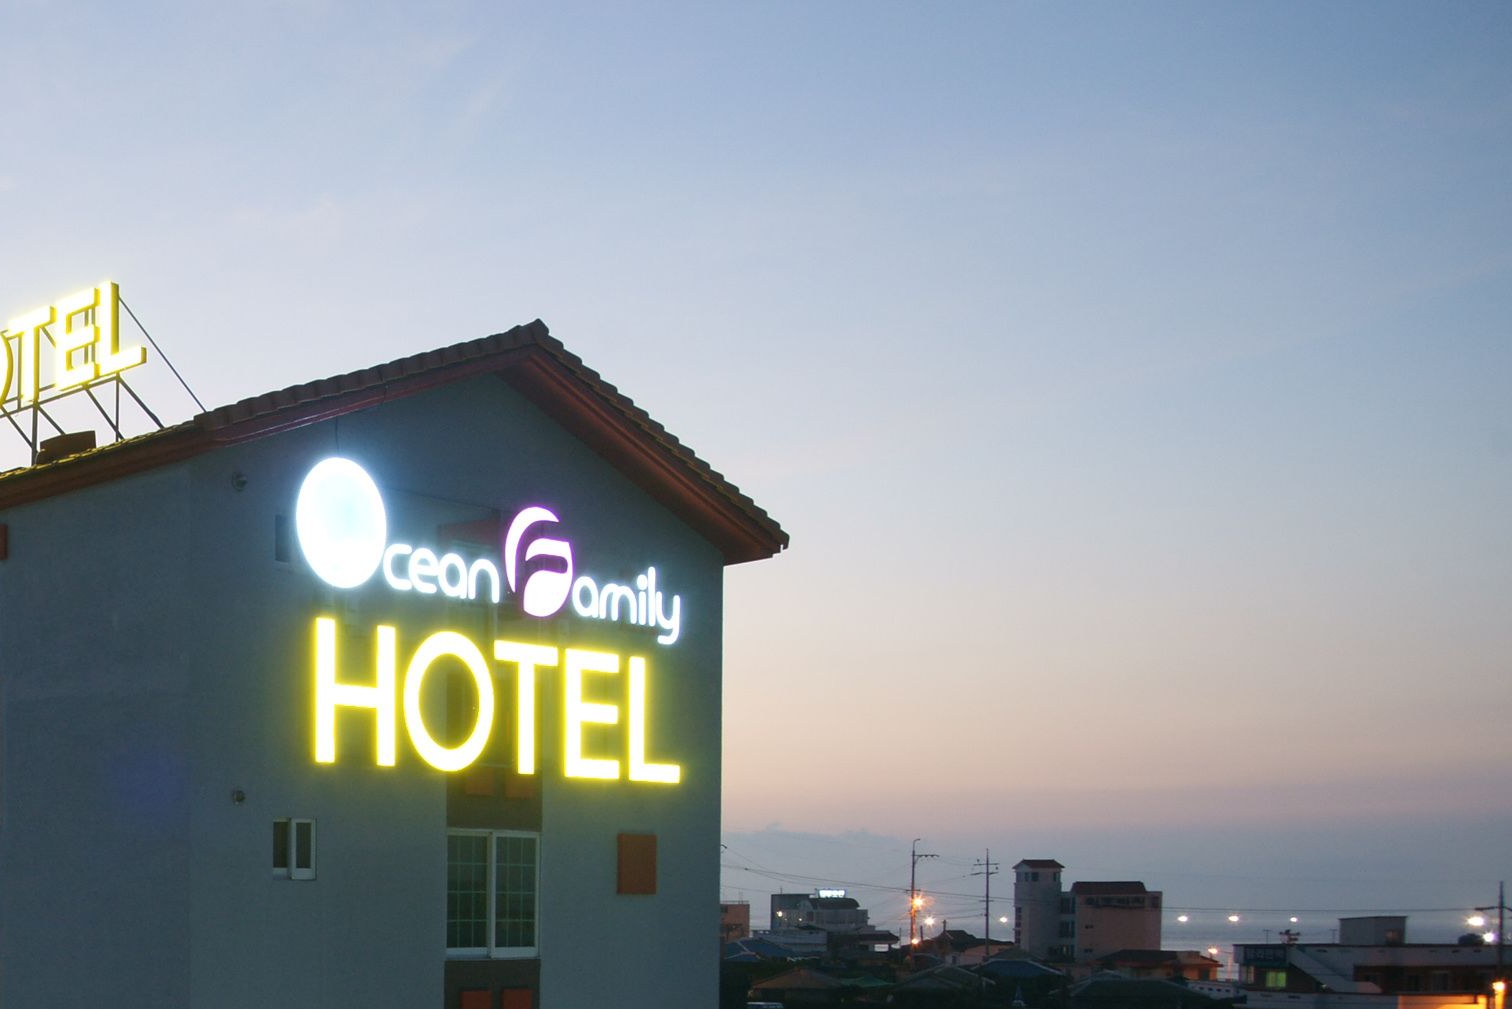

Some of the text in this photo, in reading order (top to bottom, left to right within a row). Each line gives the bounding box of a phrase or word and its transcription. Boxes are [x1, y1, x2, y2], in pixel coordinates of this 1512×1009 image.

[296, 457, 681, 645] Ocean Family
[314, 616, 681, 785] HOTEL
